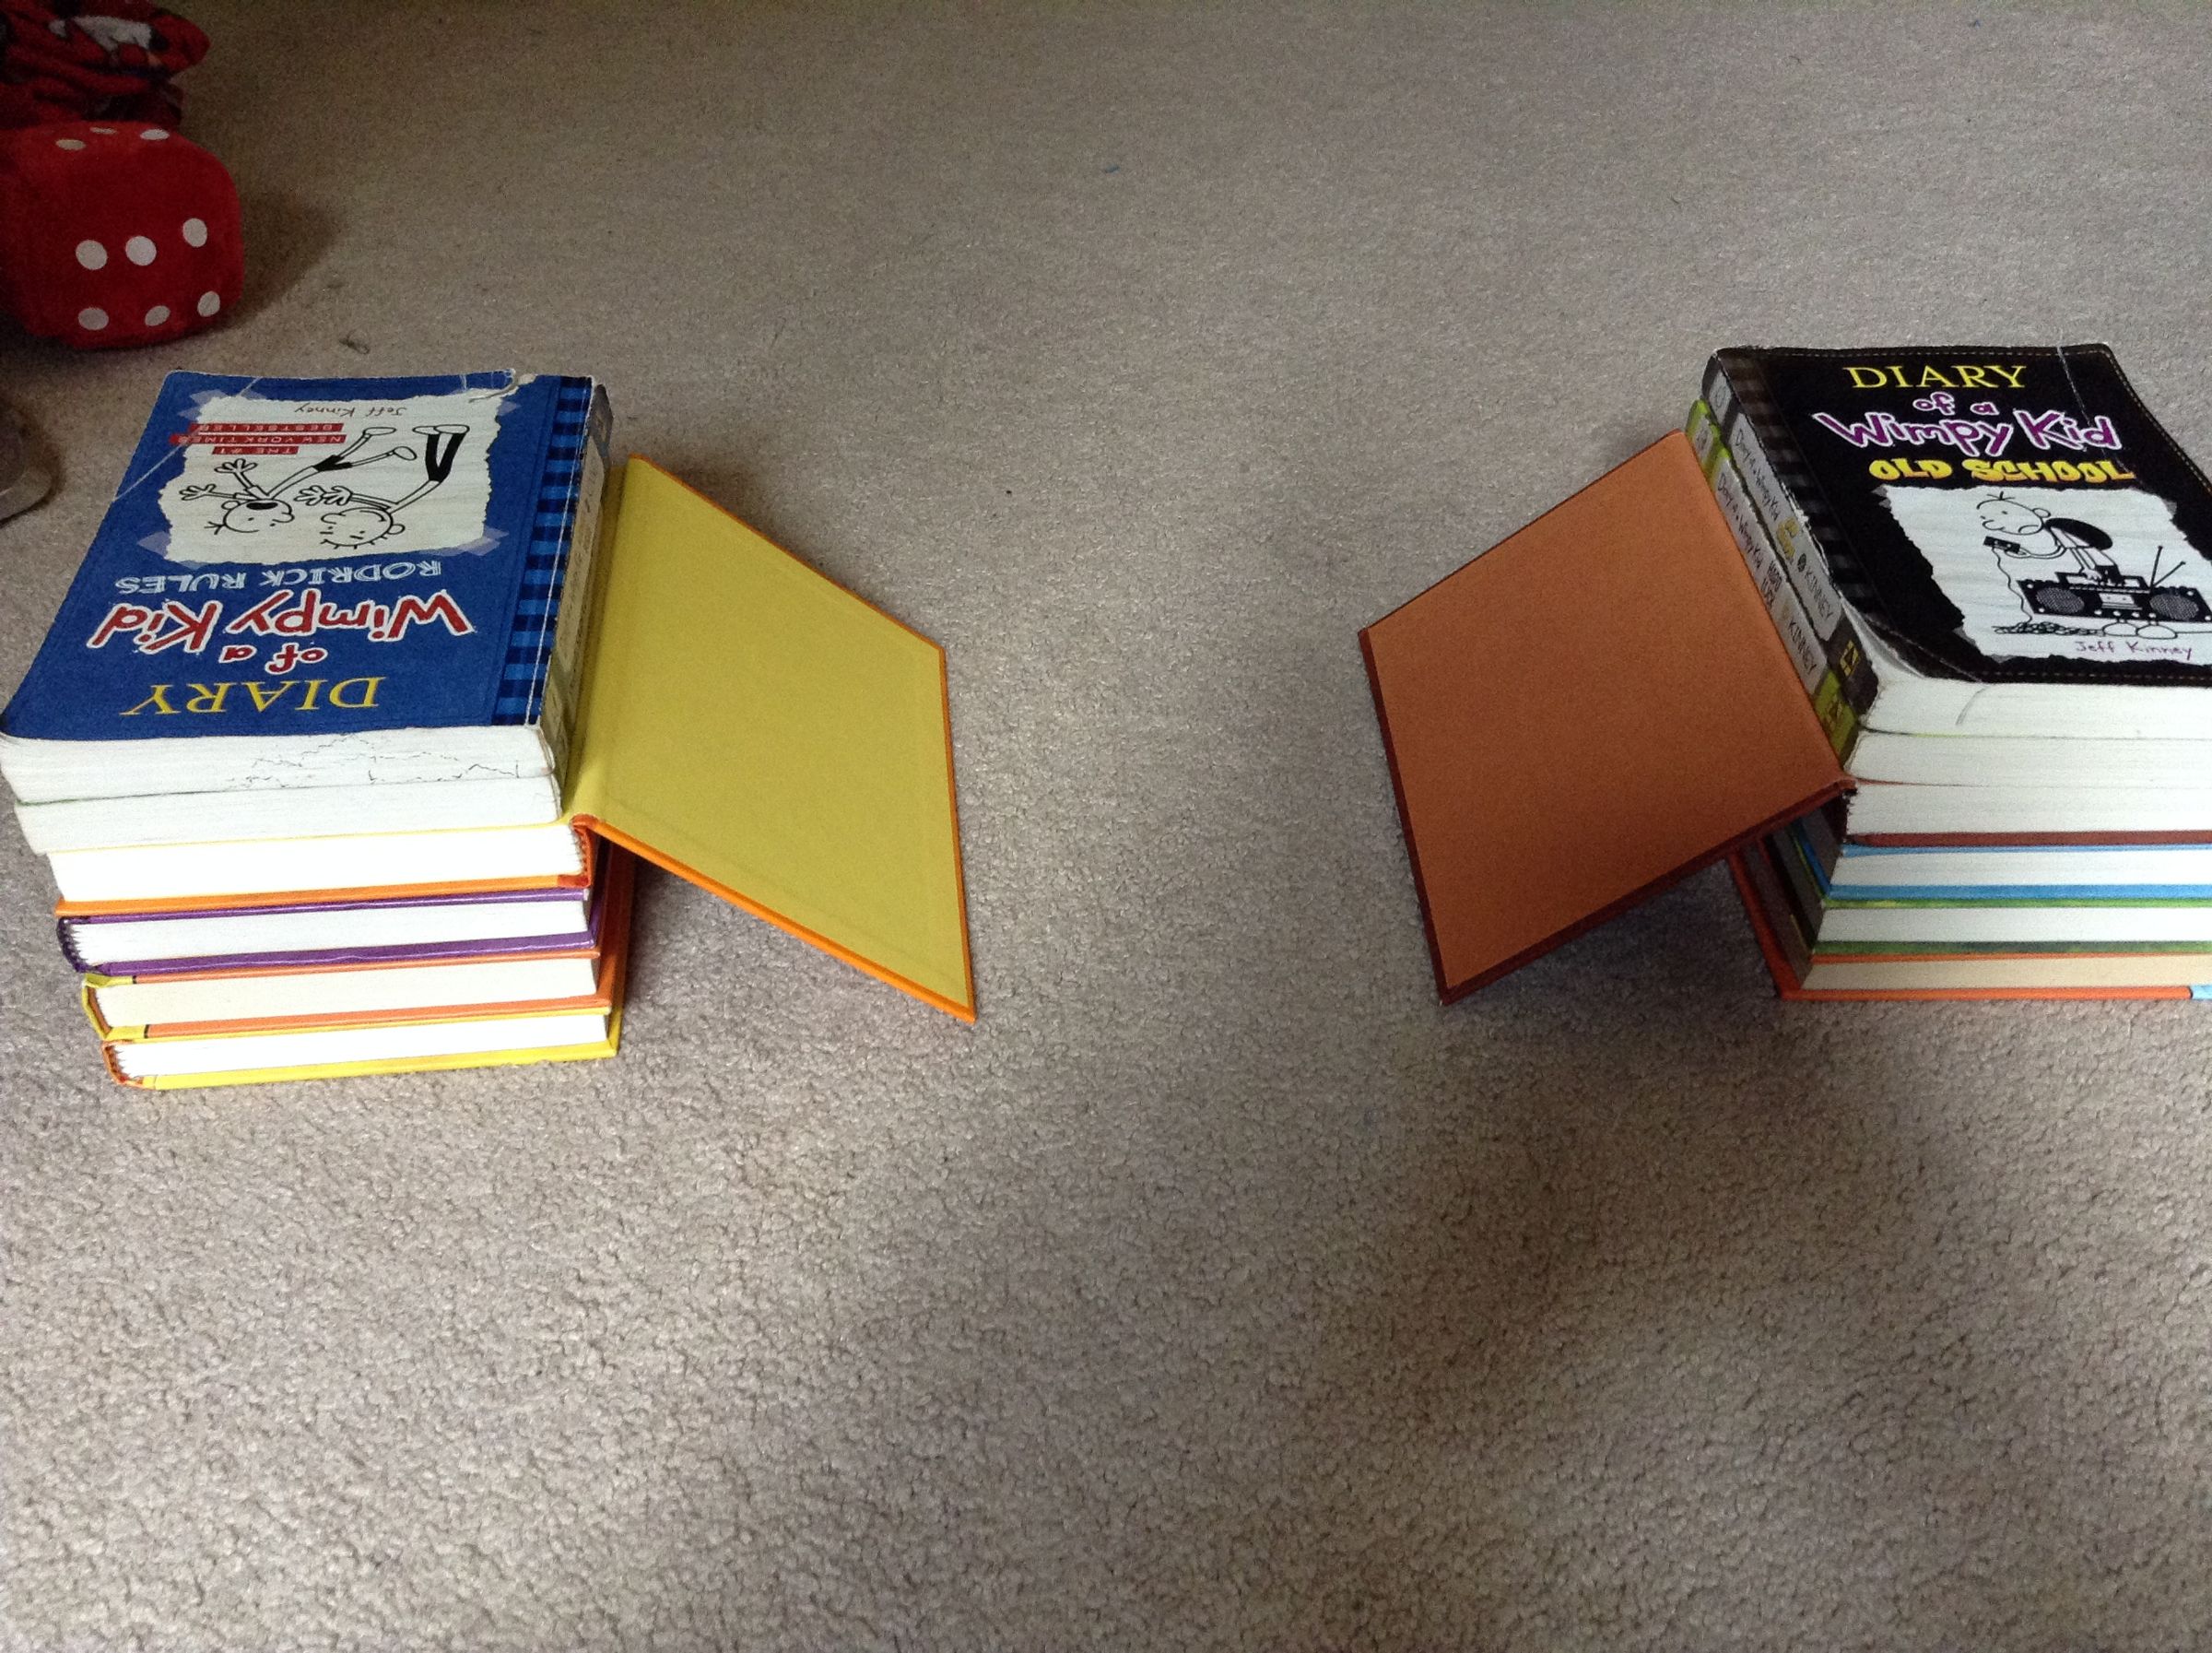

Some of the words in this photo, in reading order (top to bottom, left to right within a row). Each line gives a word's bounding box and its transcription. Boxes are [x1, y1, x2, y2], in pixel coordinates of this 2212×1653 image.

[1843, 365, 2026, 388] DIARY
[295, 403, 356, 417] Kinney
[369, 407, 406, 417] Jeff
[1913, 391, 1955, 415] of
[1970, 401, 1999, 415] a
[1811, 411, 2013, 456] Wimpy
[2013, 409, 2122, 450] Kid
[1869, 458, 1953, 480] OLD
[1961, 459, 2136, 482] SCHOOL
[115, 573, 245, 595] RULES
[261, 561, 442, 587] RODRICK
[87, 600, 223, 654] Kid
[224, 588, 476, 643] Wimpy
[218, 645, 257, 663] a
[265, 643, 328, 674] of
[2075, 641, 2114, 653] Jeff
[2125, 641, 2192, 660] Kinney
[120, 677, 386, 715] DIARY
